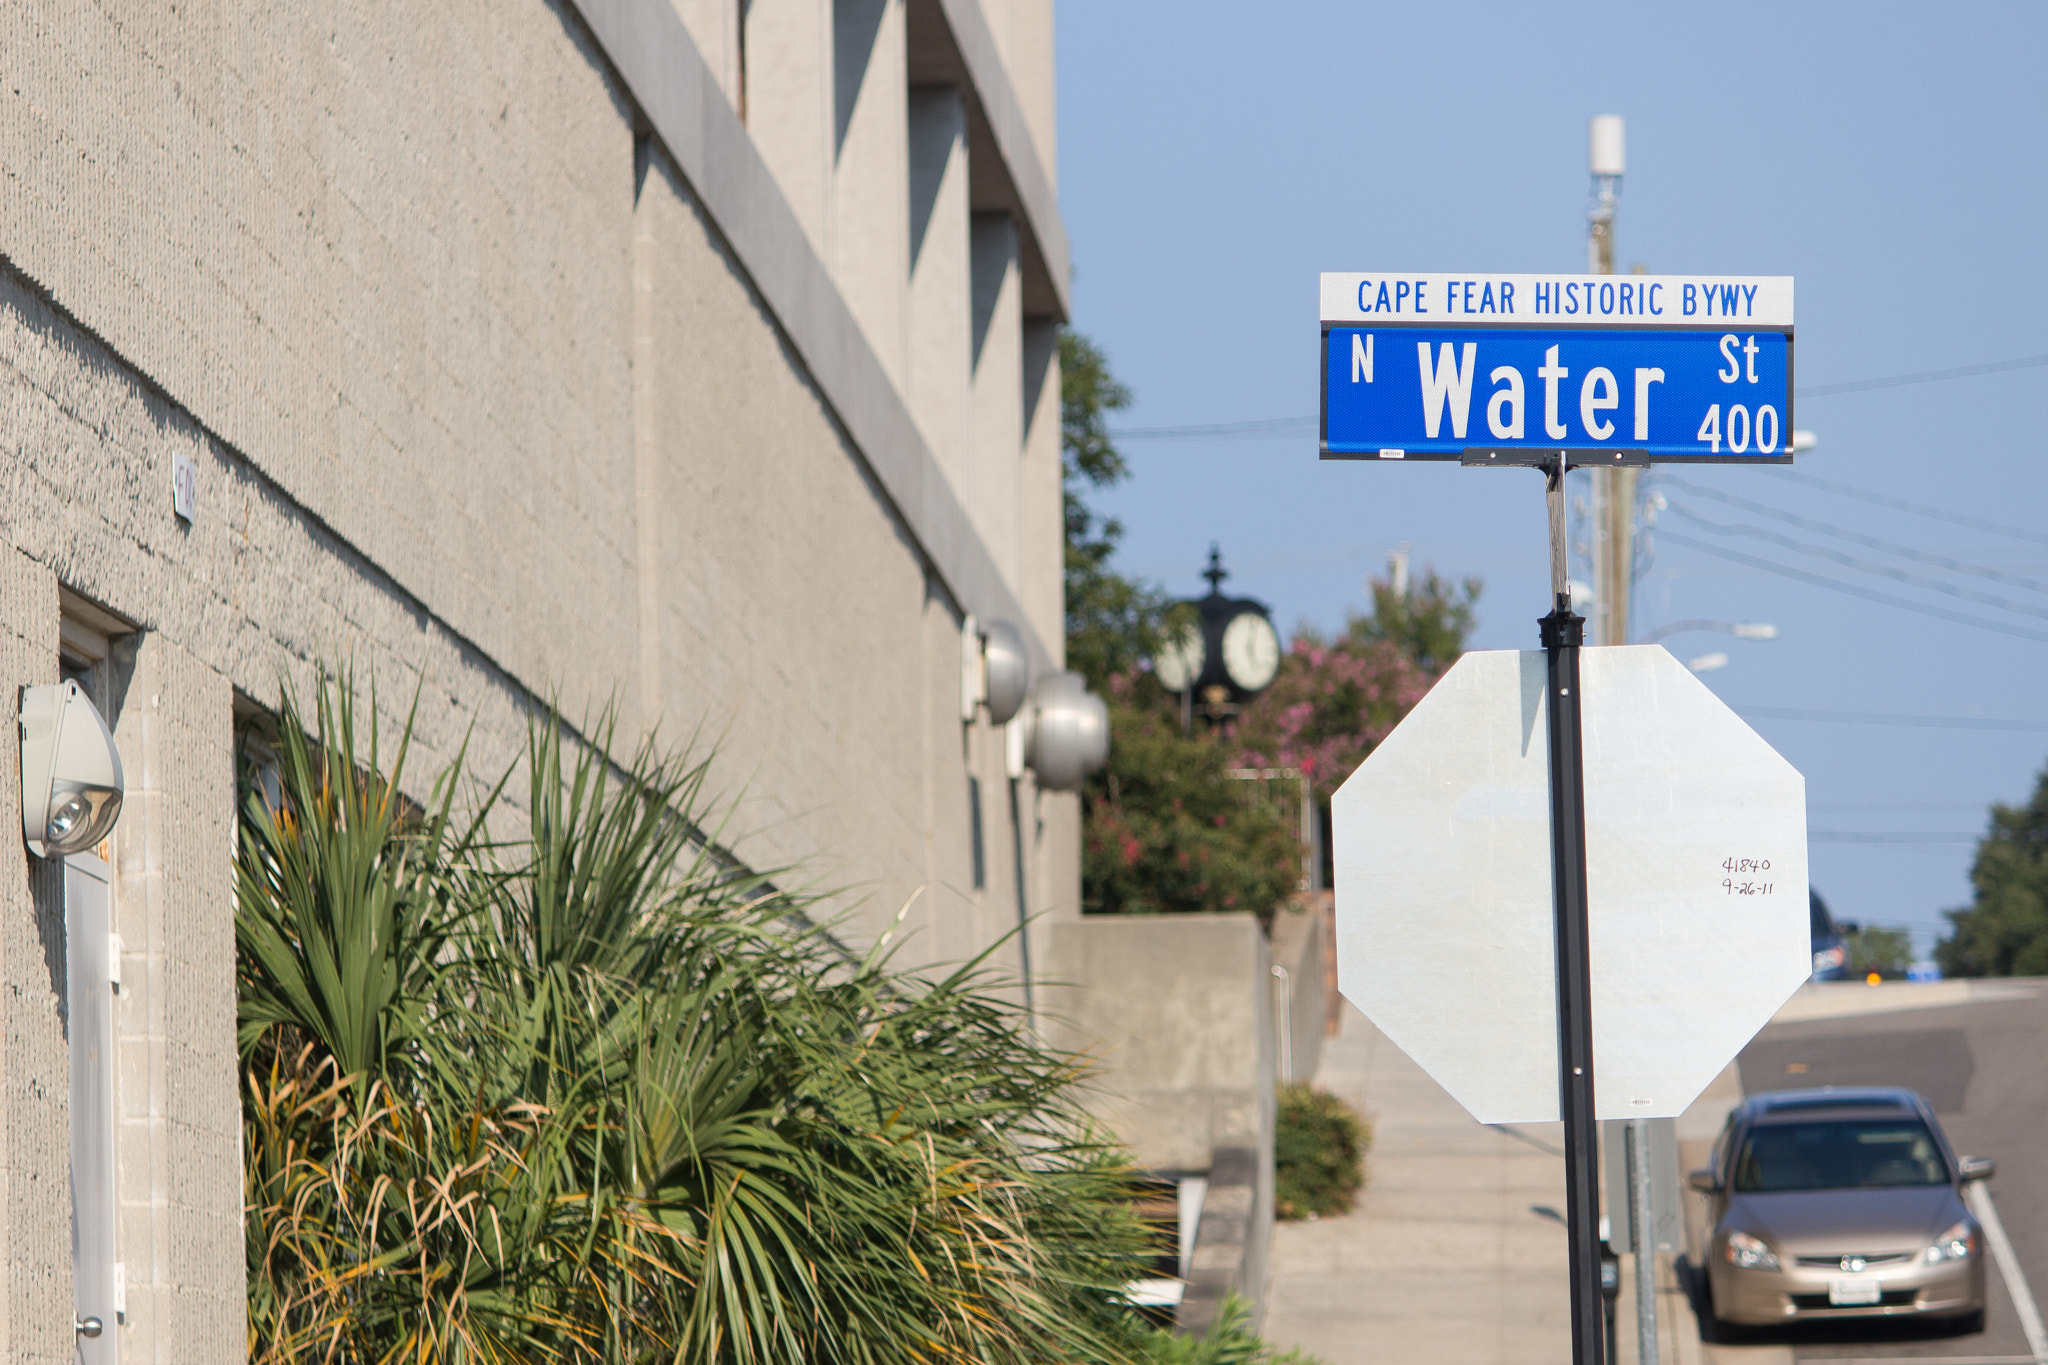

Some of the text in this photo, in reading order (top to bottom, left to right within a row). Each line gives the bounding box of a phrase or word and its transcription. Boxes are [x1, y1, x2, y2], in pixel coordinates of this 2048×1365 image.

[1357, 280, 1758, 316] CAPE FEAR HISTORIC BYWY
[1351, 334, 1760, 440] N Water St
[1698, 404, 1779, 453] 400
[1722, 857, 1771, 873] 41840
[1722, 878, 1773, 895] 9-26-11
